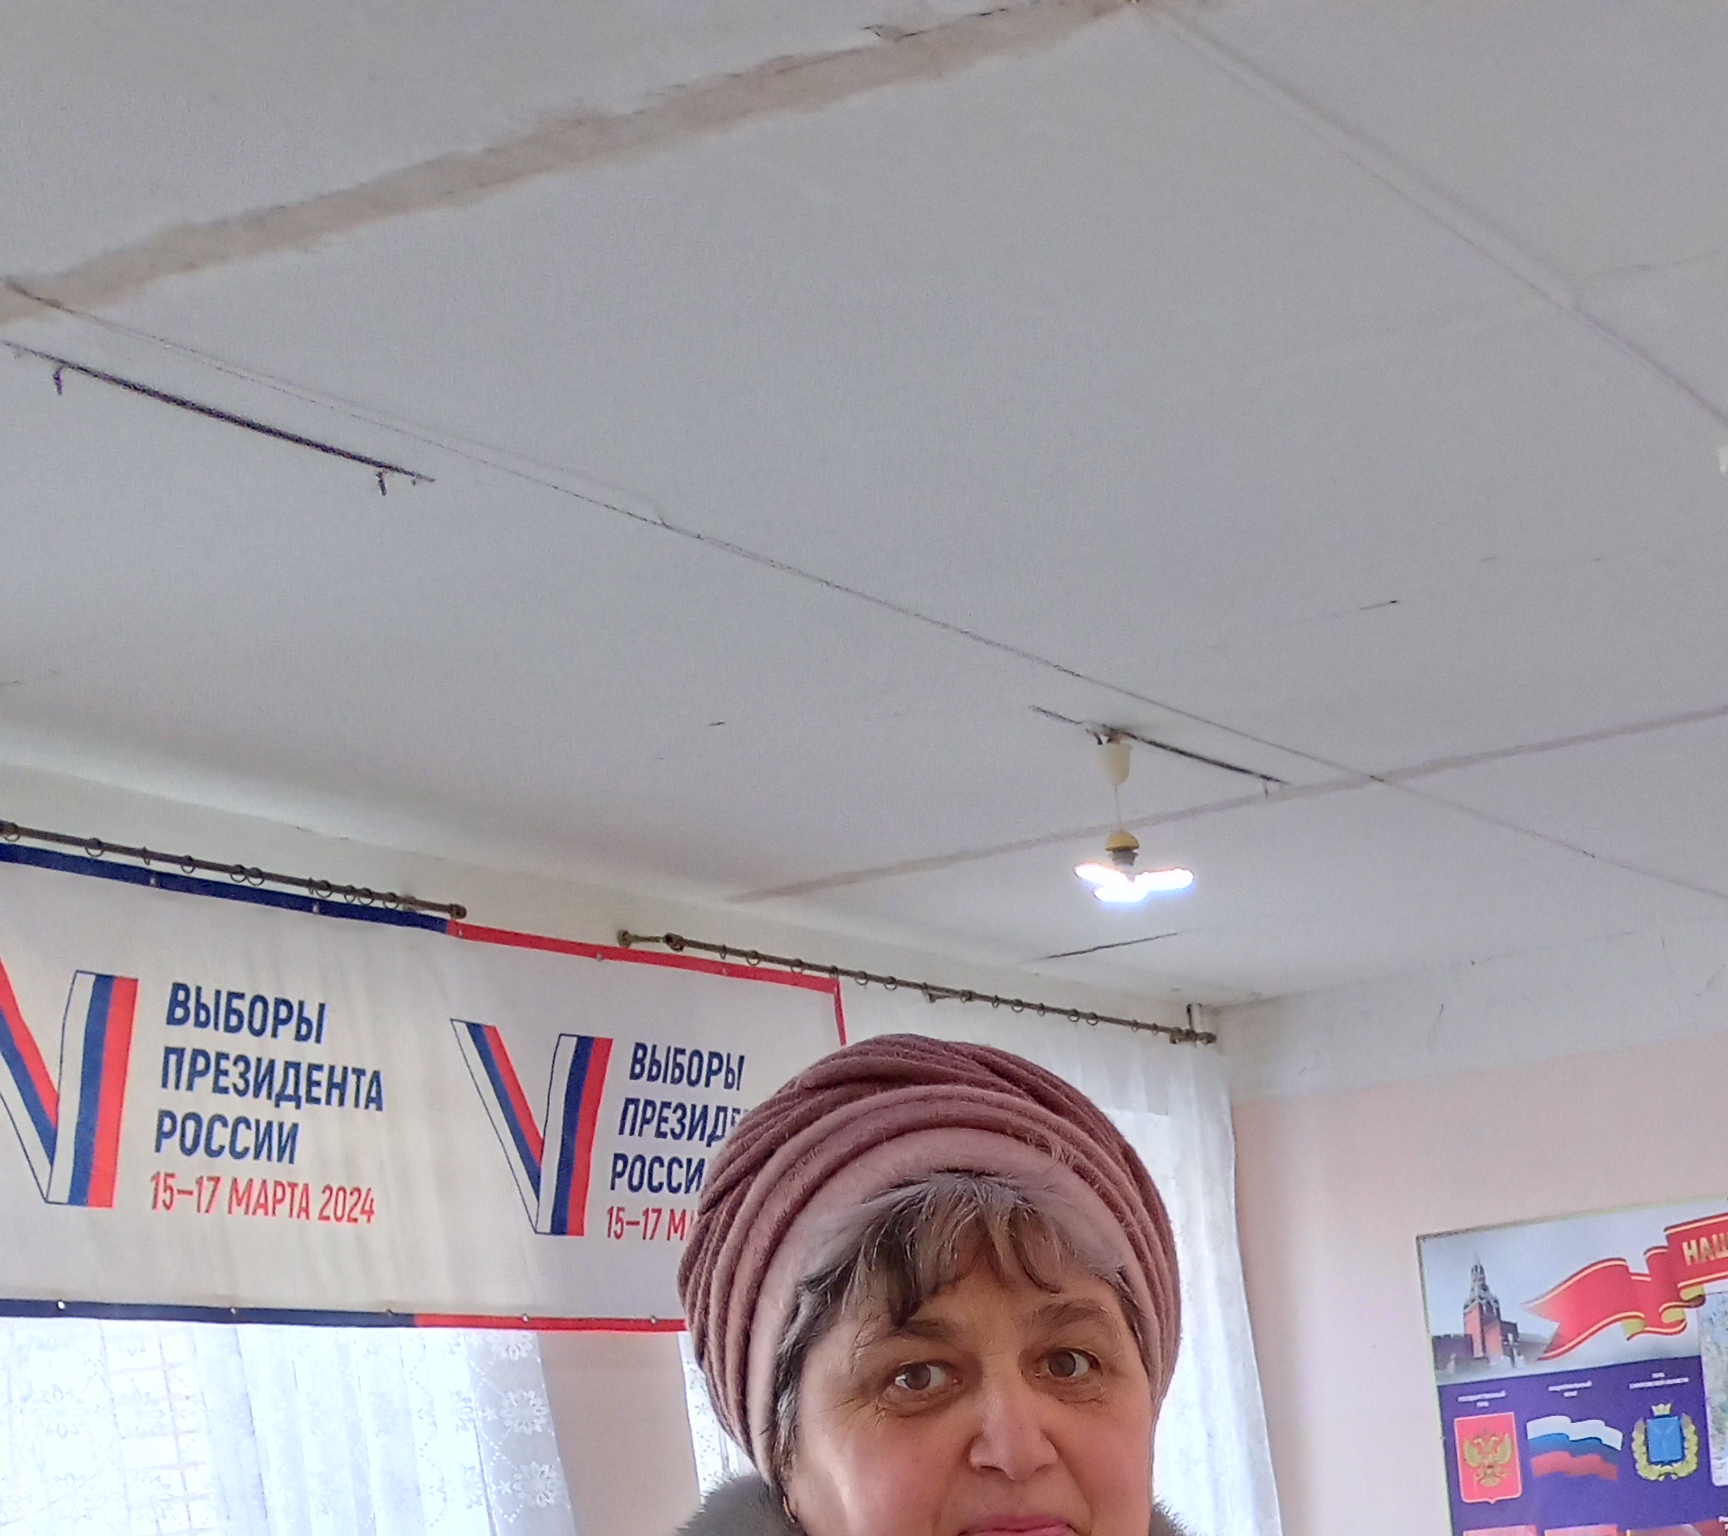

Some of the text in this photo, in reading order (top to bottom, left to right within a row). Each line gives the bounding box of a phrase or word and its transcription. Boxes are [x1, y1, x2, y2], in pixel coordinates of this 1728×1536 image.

[165, 981, 327, 1045] ВЫБОРЫ
[161, 1045, 384, 1112] ПРЕЗИДЕНТА
[629, 1041, 745, 1091] ВЫБОРЫ
[154, 1108, 300, 1165] РОССИИ
[618, 1096, 750, 1148] ПРЕЗИД
[610, 1152, 706, 1195] РОССИ
[227, 1176, 311, 1221] МАРТА
[318, 1183, 376, 1224] 2024
